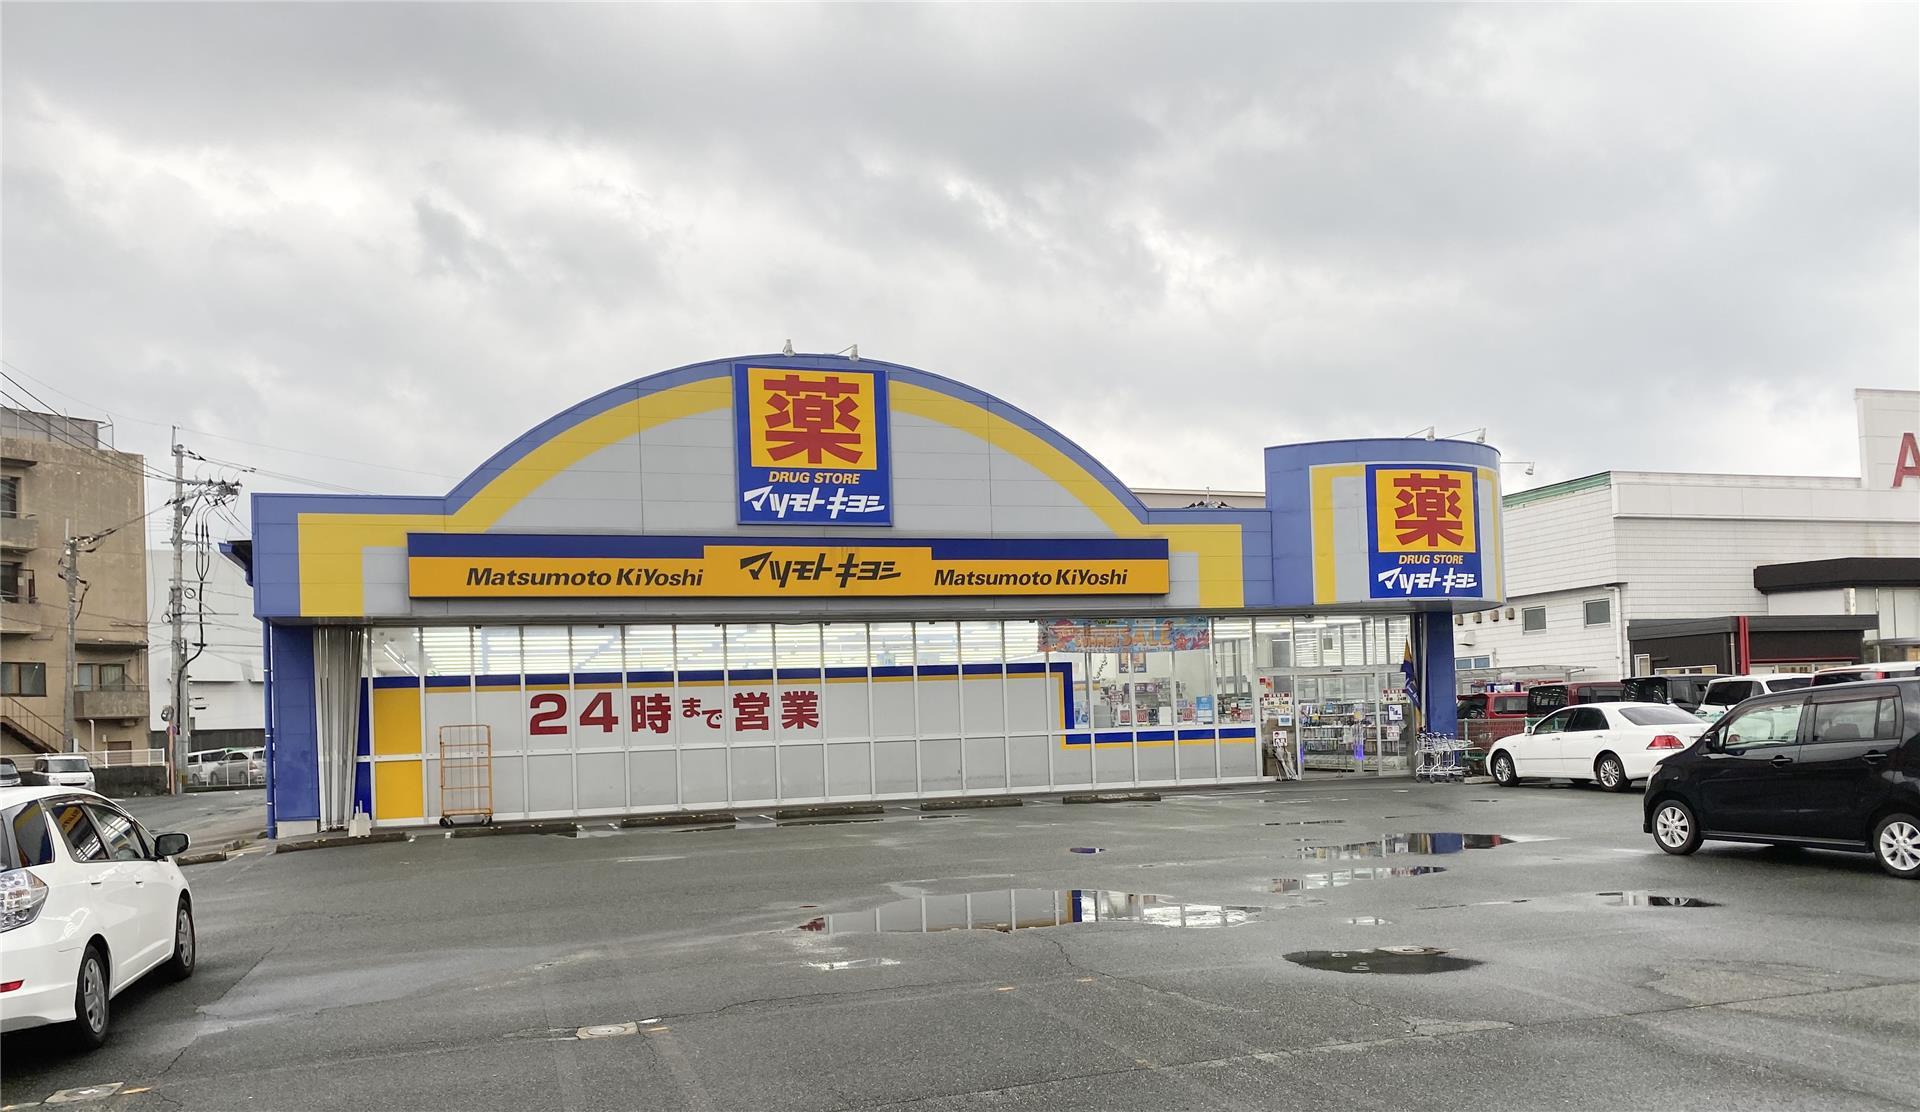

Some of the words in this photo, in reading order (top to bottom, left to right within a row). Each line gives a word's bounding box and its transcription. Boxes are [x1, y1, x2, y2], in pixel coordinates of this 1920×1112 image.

[764, 374, 864, 465] 薬
[768, 471, 811, 484] DRUG
[813, 472, 861, 485] STORE
[743, 485, 886, 519] マツモトキヨシ
[1393, 473, 1465, 547] 薬
[739, 551, 902, 588] マツモトキヨシ
[1398, 554, 1431, 565] DRUG
[1433, 554, 1464, 565] STORE
[466, 567, 612, 586] Matsumoto
[615, 567, 704, 586] KiYoshi
[933, 568, 1052, 586] Matsumoto
[1055, 568, 1129, 586] KiYoshi
[1377, 566, 1478, 595] マツモトキヨシ
[529, 690, 820, 736] 24時まで営業
